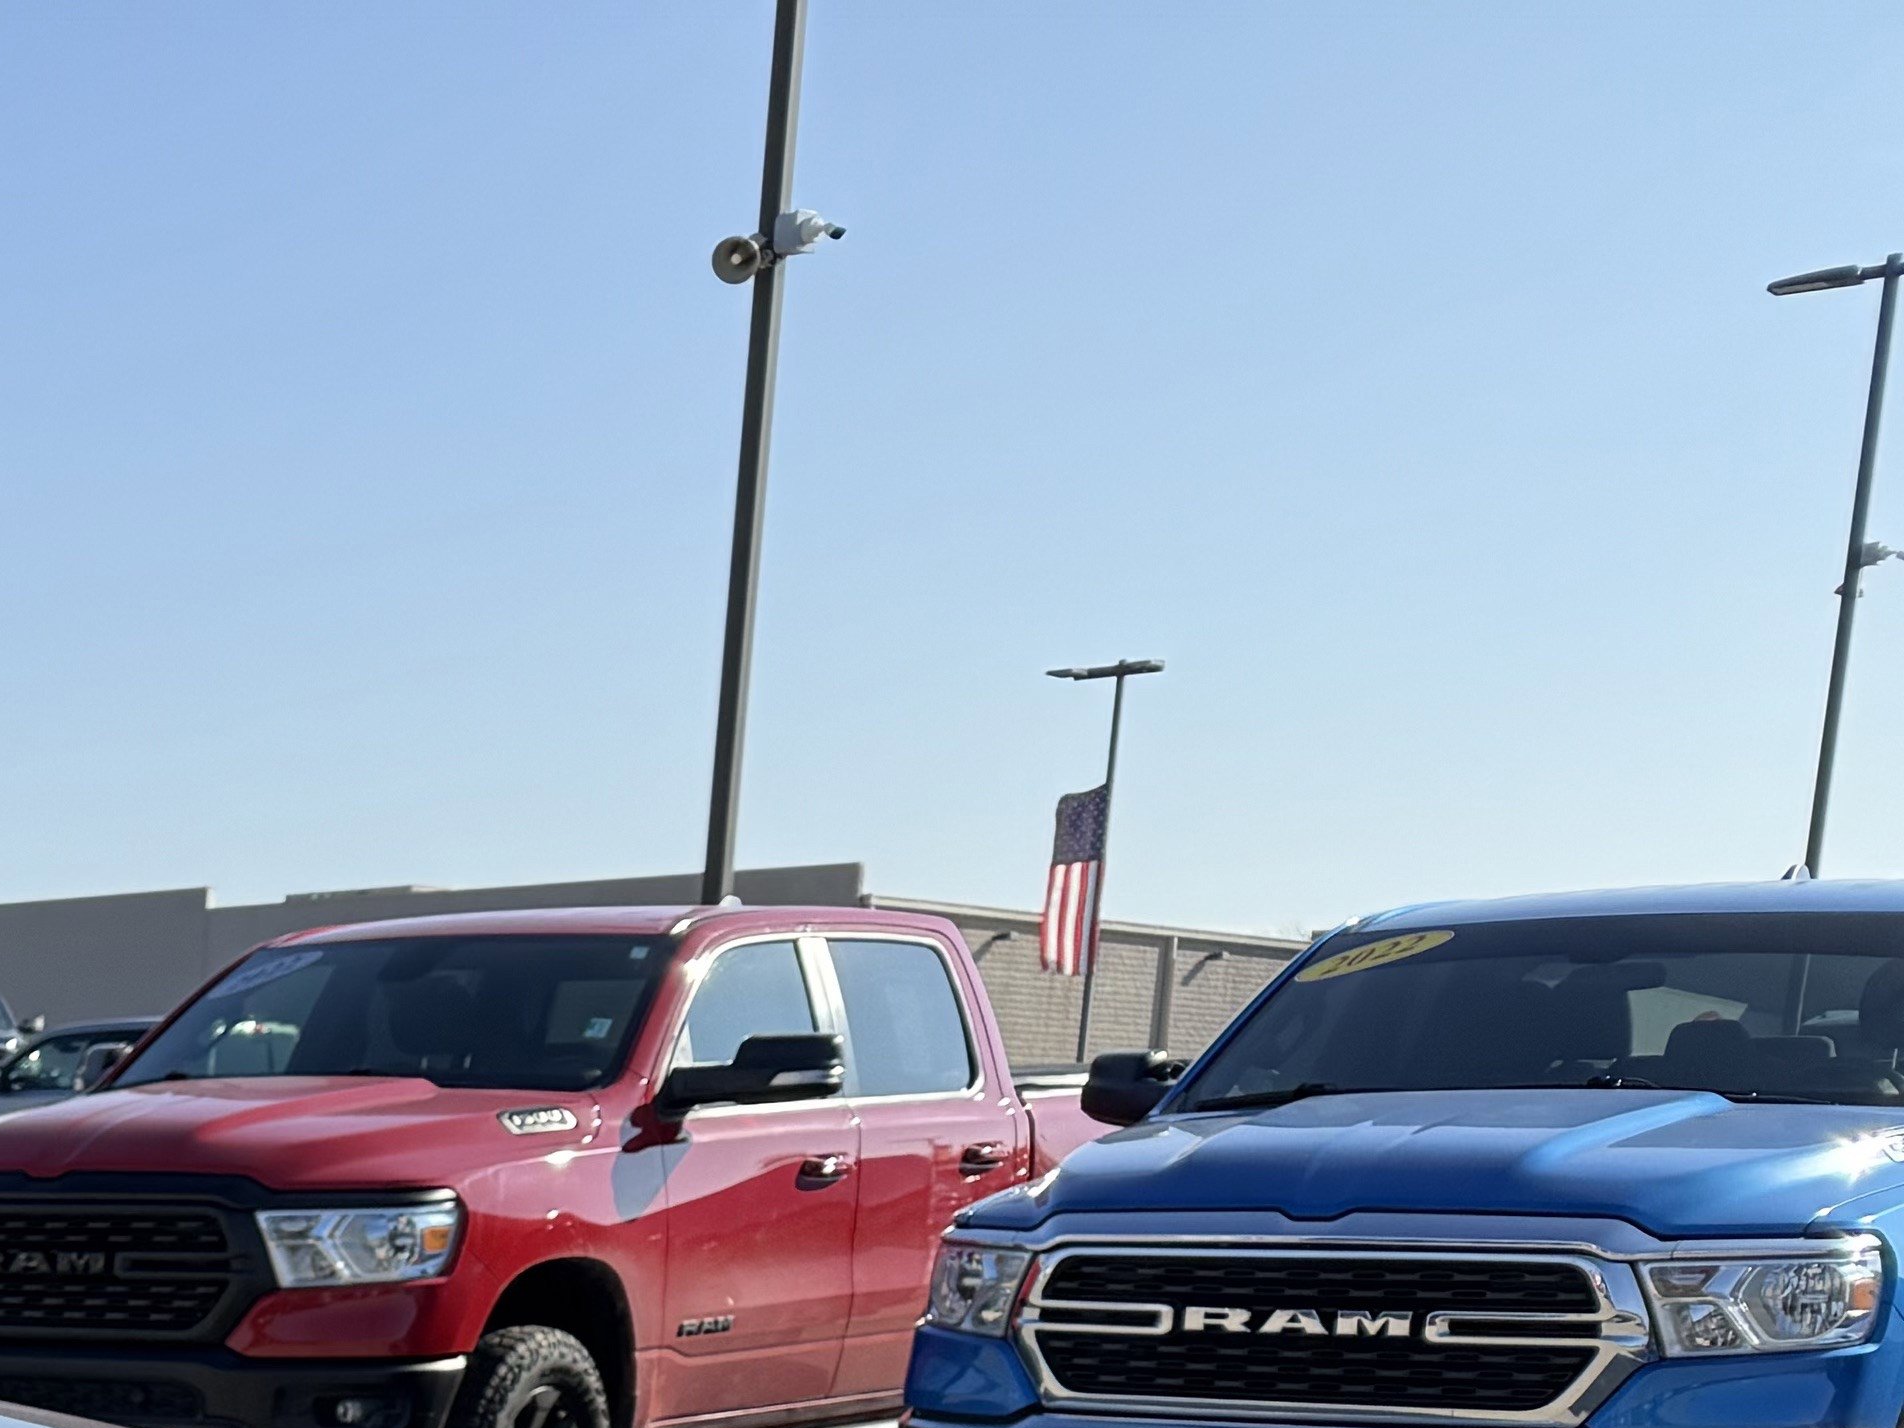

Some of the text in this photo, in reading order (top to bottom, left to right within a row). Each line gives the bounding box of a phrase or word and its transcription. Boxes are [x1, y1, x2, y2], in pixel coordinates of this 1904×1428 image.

[1318, 933, 1428, 977] 2022
[676, 1314, 734, 1337] RAM
[1184, 1306, 1414, 1336] RAM
